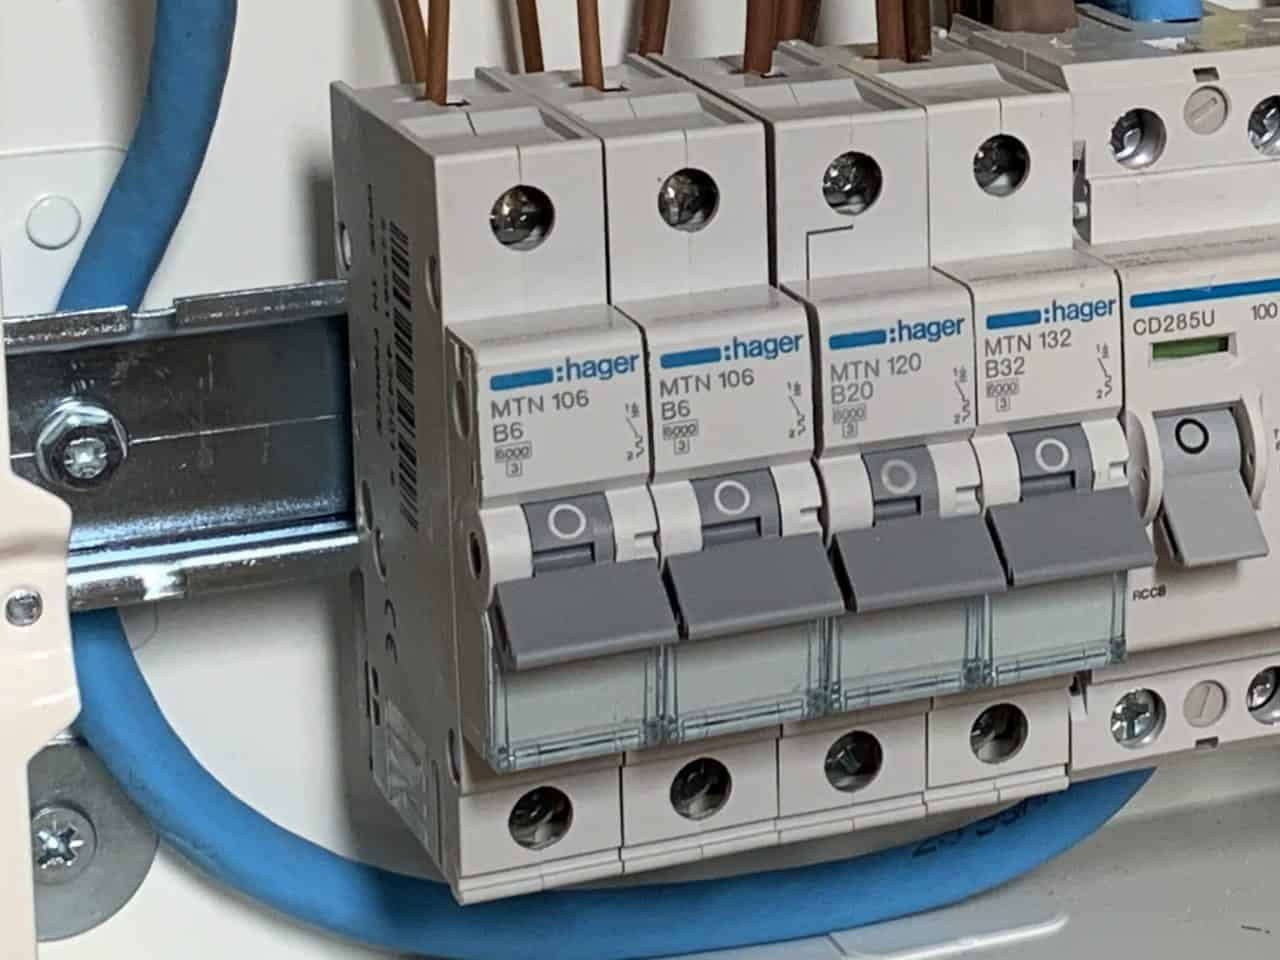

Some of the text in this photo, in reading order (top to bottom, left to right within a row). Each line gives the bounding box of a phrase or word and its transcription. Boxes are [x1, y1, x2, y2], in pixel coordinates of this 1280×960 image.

[1131, 308, 1216, 337] CD285U
[1251, 298, 1278, 321] 100
[984, 327, 1073, 358] MTN 132
[830, 352, 922, 383] MTN 120
[985, 356, 1025, 379] B32
[660, 367, 755, 398] MTN 106
[831, 381, 874, 405] B20
[491, 389, 589, 419] MTN 106
[661, 400, 691, 421] B6
[493, 422, 524, 443] B6
